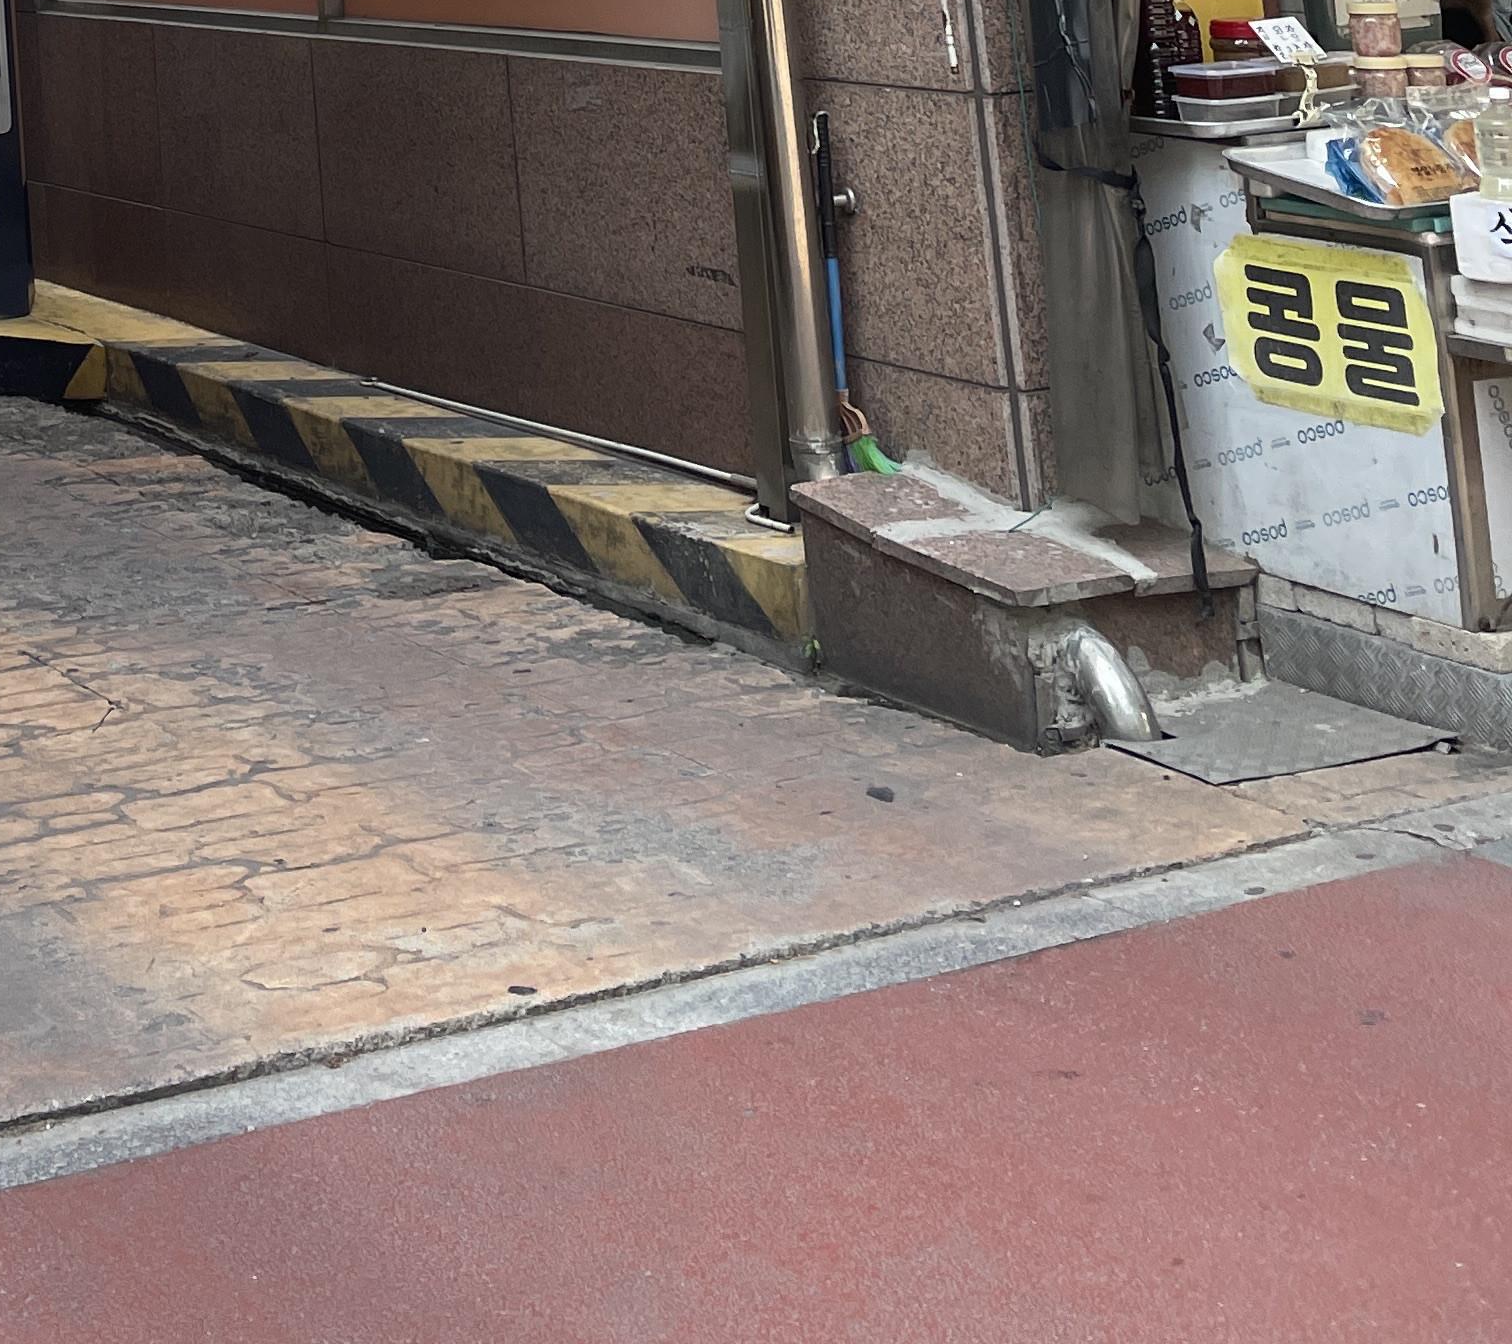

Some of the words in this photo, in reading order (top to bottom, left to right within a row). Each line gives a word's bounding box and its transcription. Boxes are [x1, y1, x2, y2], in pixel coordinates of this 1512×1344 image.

[1146, 205, 1187, 235] posco
[1169, 279, 1212, 310] posco
[1243, 263, 1420, 407] 콩물
[1218, 436, 1264, 467] posco
[1322, 498, 1372, 528] posco
[1242, 518, 1289, 546] posco
